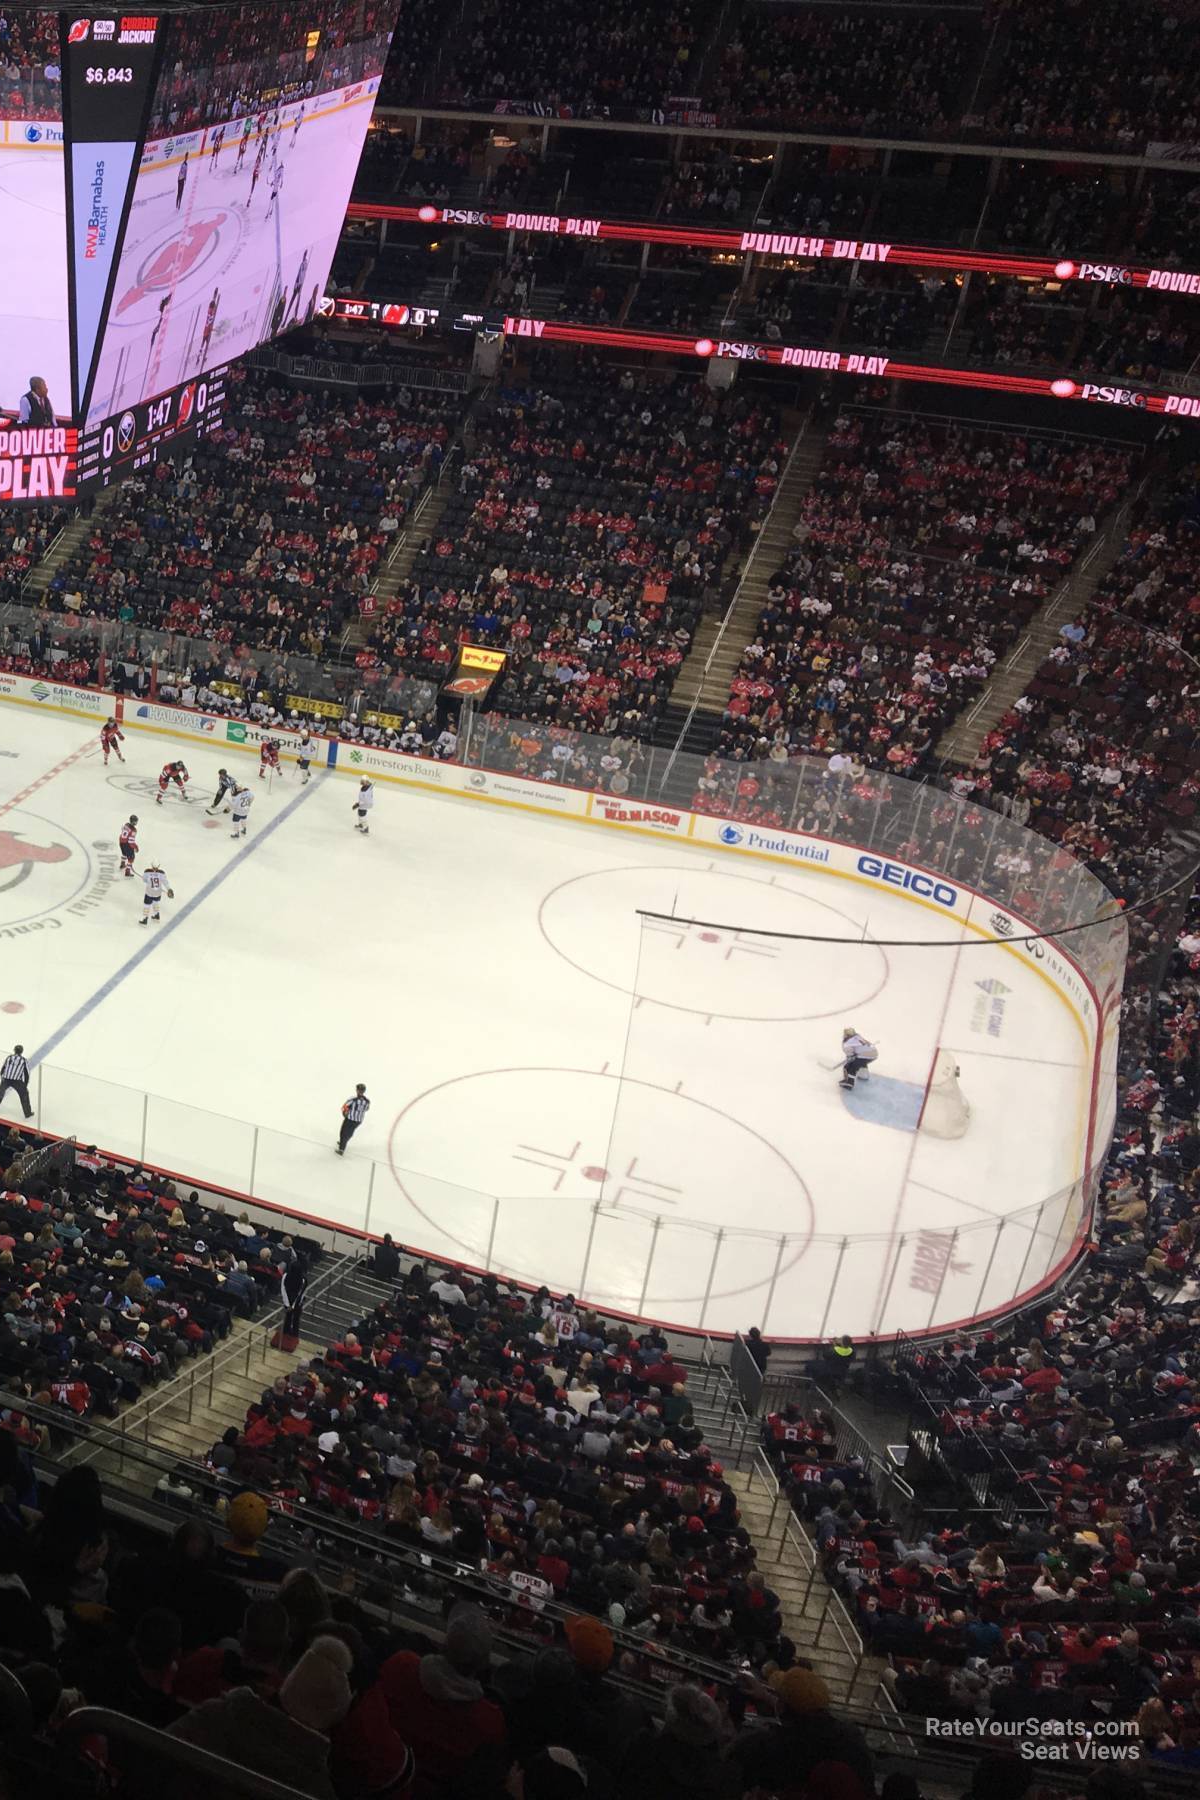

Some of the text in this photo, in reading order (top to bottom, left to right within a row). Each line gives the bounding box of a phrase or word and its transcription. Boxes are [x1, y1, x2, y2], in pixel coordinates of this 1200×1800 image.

[120, 16, 158, 30] CURRENT
[117, 30, 156, 44] JACKPOT
[86, 67, 133, 84] $6,843
[98, 206, 109, 246] HEALTH
[506, 212, 560, 233] POWER
[566, 217, 601, 237] PLAY
[414, 310, 425, 324] 0
[781, 347, 841, 371] POWER
[846, 353, 890, 376] PLAY
[196, 383, 207, 413] 0
[147, 396, 172, 432] 1:47
[103, 426, 114, 459] 0
[52, 686, 101, 703] EAST COAST
[748, 831, 830, 863] Prudential
[66, 853, 120, 917] Prudential
[150, 877, 160, 889] 19
[857, 855, 958, 907] GEICO
[556, 1317, 571, 1335] 16
[802, 1470, 822, 1483] 44
